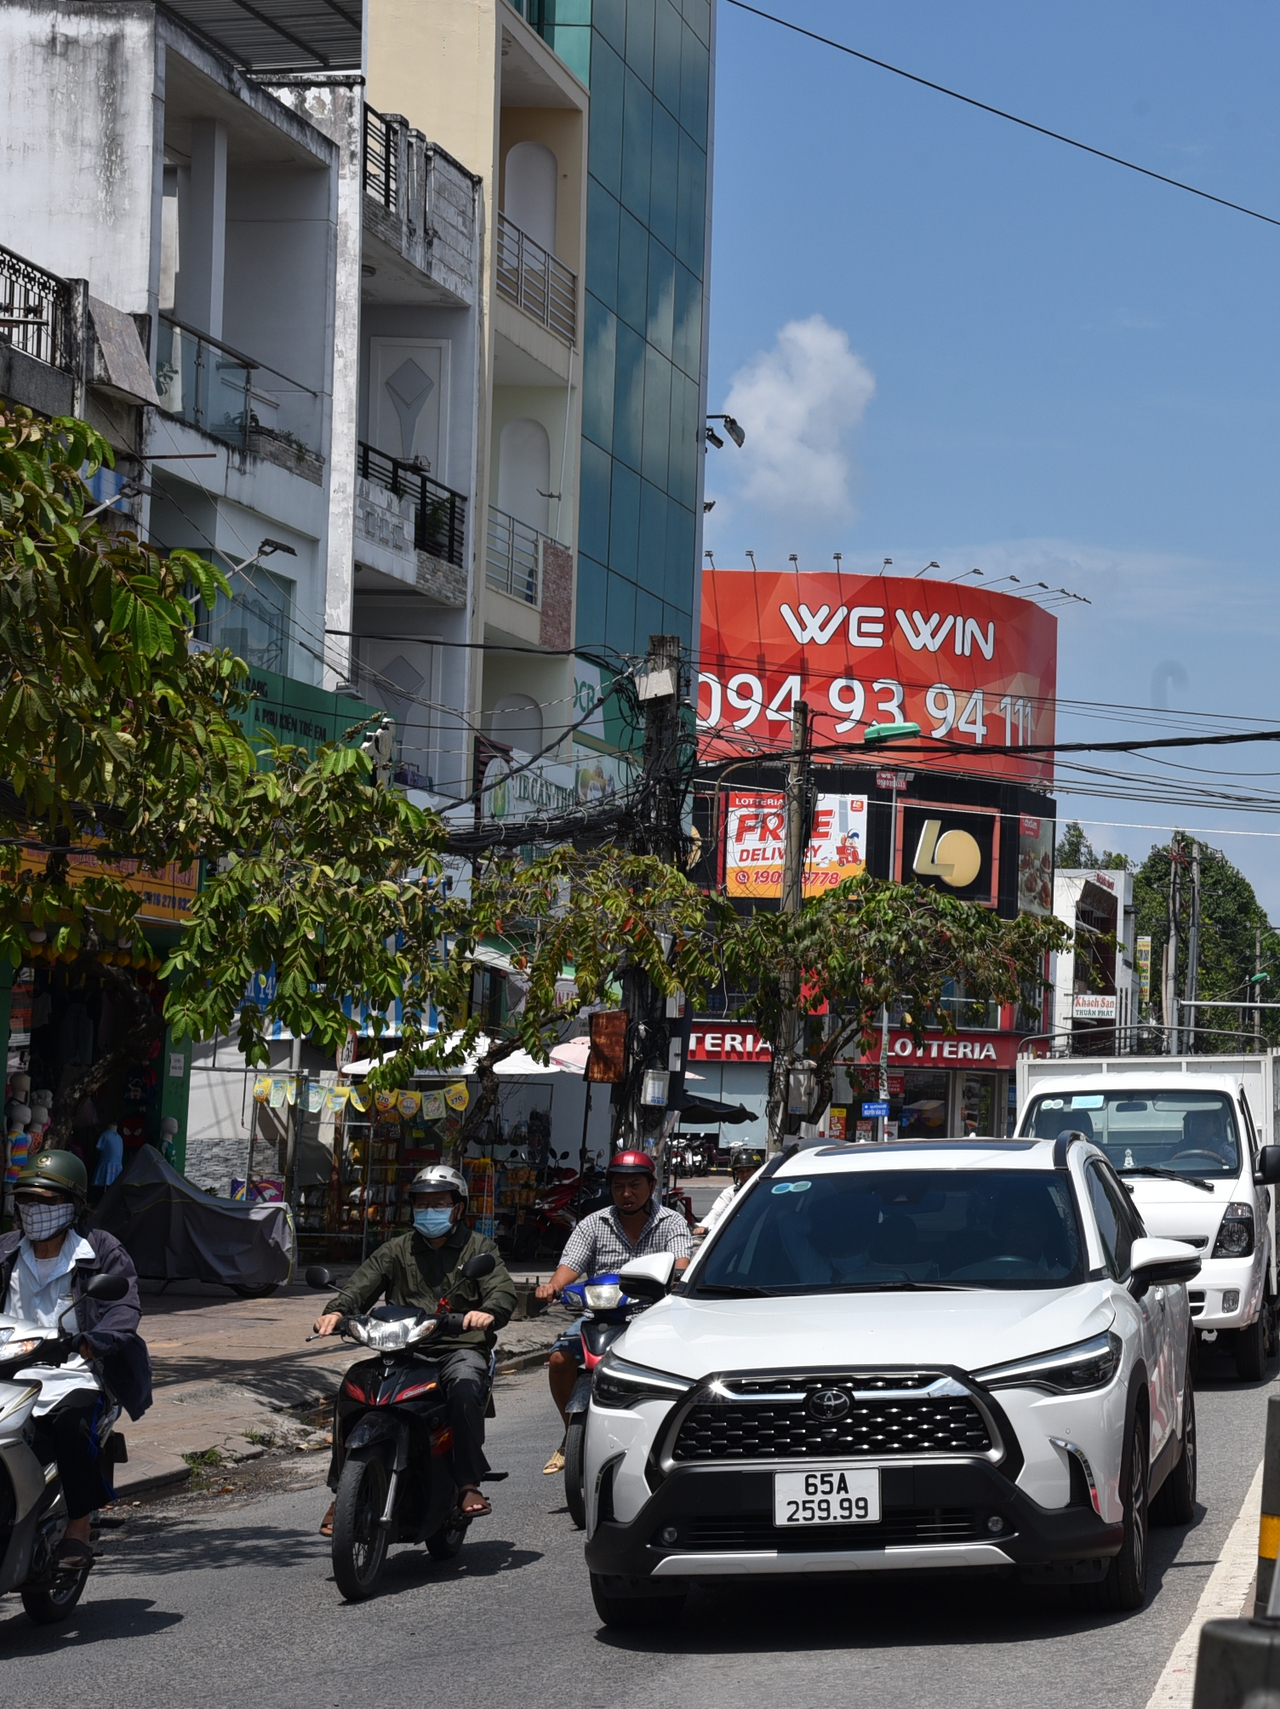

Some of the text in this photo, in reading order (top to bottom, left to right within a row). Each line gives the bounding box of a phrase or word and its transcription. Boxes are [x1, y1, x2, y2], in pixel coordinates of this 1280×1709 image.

[779, 603, 995, 661] WE WIN
[697, 673, 1033, 748] 094 93 94 111
[735, 798, 784, 806] LOTTERIA
[735, 809, 835, 843] FRE
[739, 845, 823, 863] DELIVRY
[753, 870, 783, 885] 190
[689, 1033, 772, 1053] TERIA
[376, 1094, 389, 1103] 270
[451, 1095, 463, 1105] 270
[804, 1472, 850, 1496] 65A
[786, 1497, 869, 1522] 259.99
